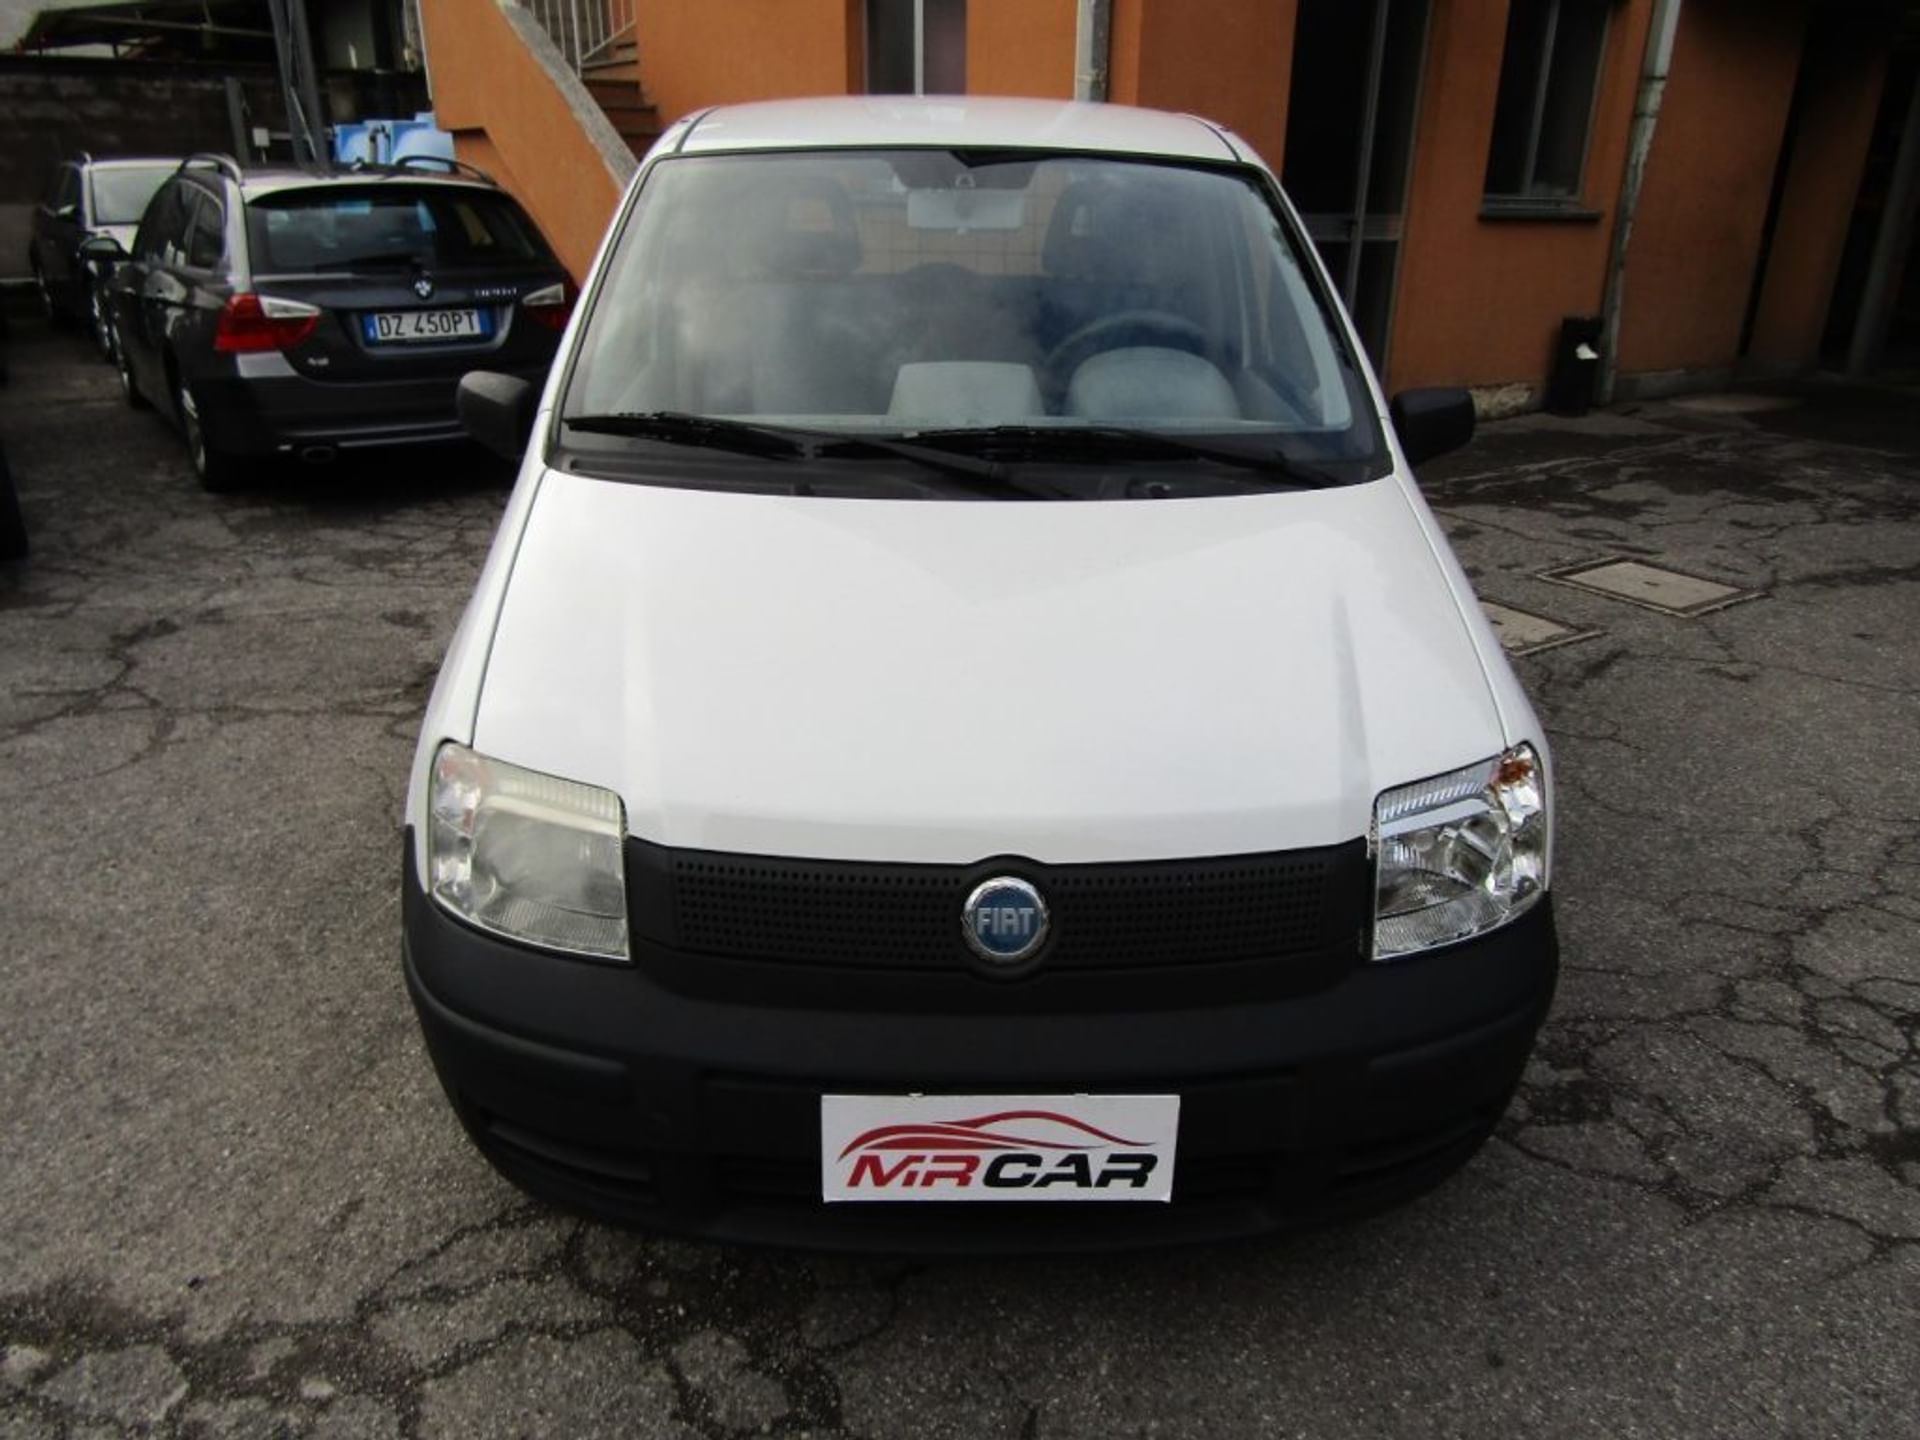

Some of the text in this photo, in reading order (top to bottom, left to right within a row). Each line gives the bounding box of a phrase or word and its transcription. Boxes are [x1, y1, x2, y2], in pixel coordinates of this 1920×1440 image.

[378, 315, 405, 337] DZ
[414, 310, 475, 334] 450PT
[977, 907, 1034, 935] FIAT
